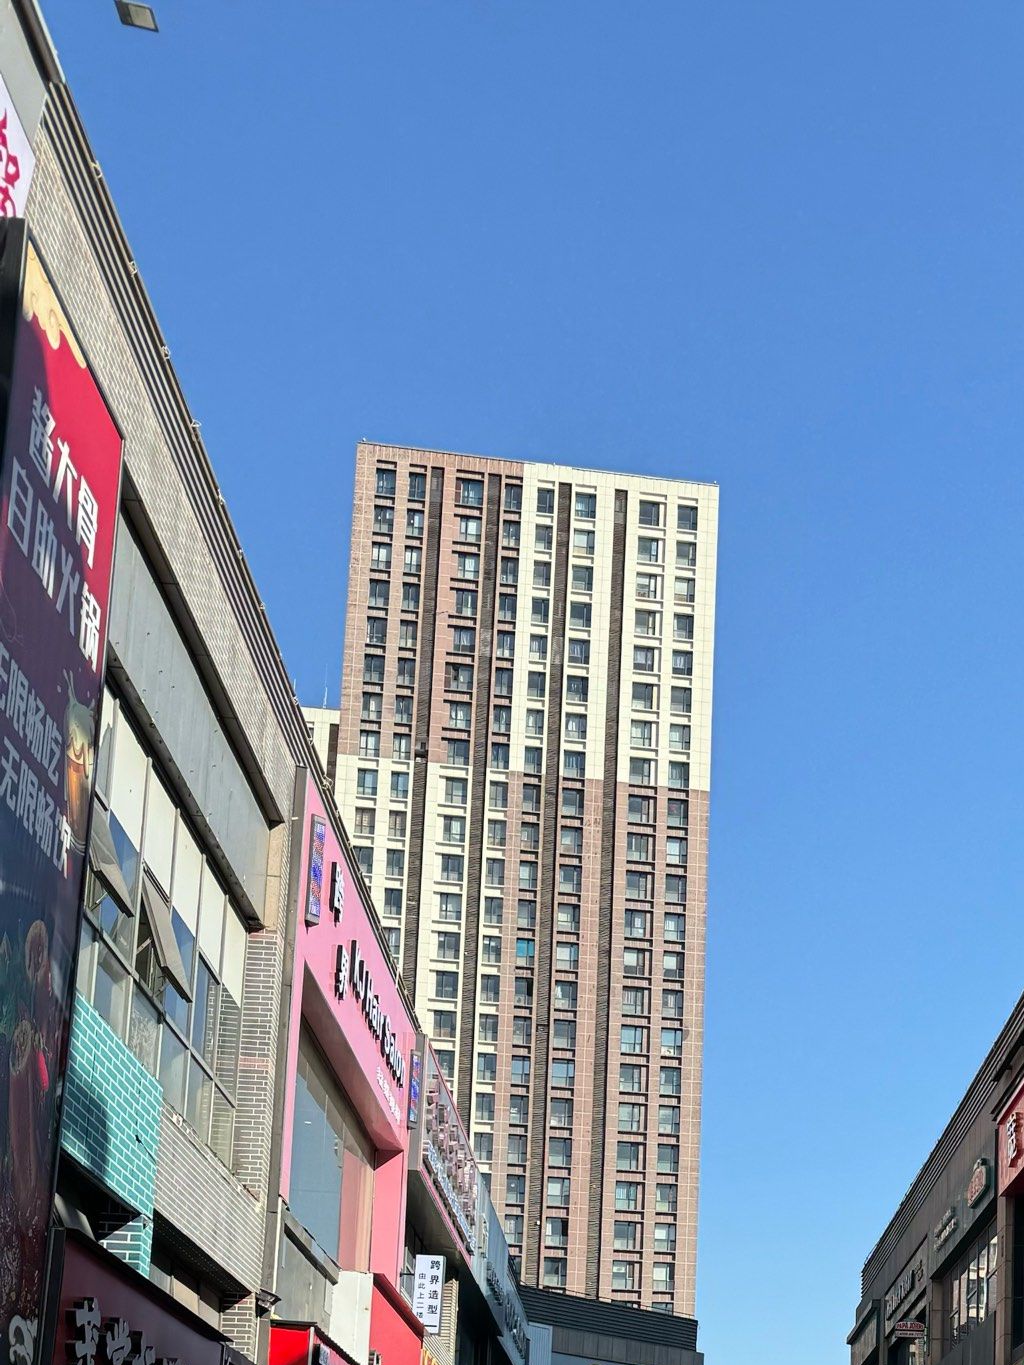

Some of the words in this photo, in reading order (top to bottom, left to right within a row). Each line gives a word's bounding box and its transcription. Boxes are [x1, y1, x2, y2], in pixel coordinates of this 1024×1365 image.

[7, 456, 101, 673] 自助火锅
[1, 737, 71, 880] 无限畅饮
[364, 971, 386, 1041] Hair
[382, 1013, 406, 1087] Salon
[427, 1260, 441, 1315] 跨界造型
